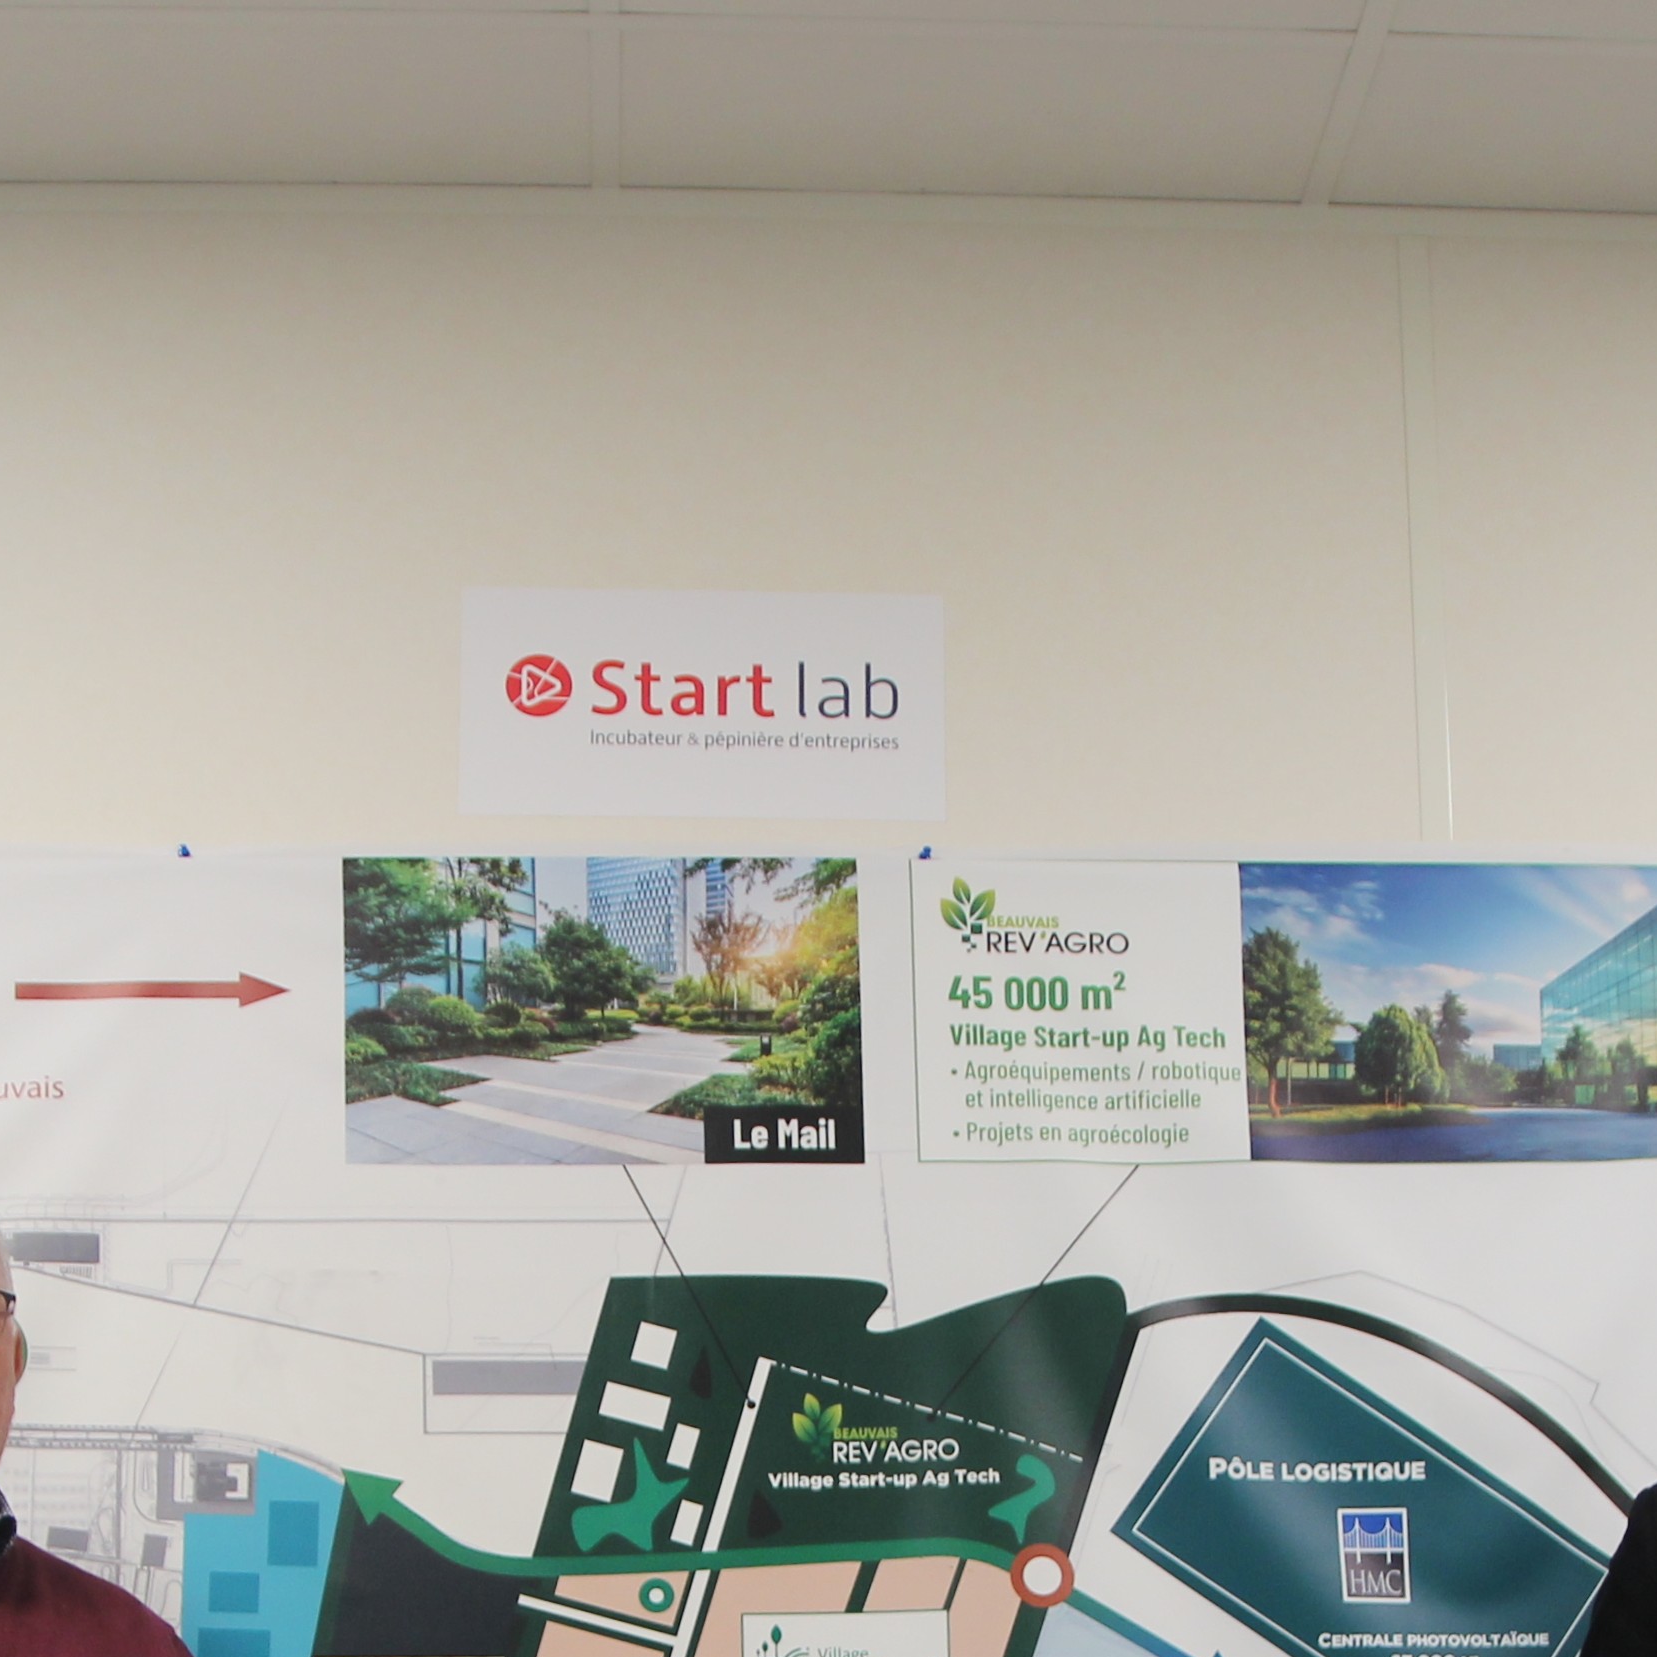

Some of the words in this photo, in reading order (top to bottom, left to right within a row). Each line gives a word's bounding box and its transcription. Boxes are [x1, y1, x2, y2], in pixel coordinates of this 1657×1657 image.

[591, 659, 776, 718] Start
[797, 661, 900, 720] lab
[590, 729, 683, 747] Incubateur
[687, 732, 700, 748] &
[704, 730, 784, 751] pépinière
[789, 732, 900, 752] d'entreprises
[986, 916, 1060, 929] BEAUVAIS
[948, 975, 993, 1011] 45
[1004, 976, 1069, 1011] 000
[949, 1024, 1027, 1051] Village
[1034, 1025, 1130, 1052] Start-up
[1137, 1025, 1166, 1051] Ag
[1173, 1026, 1226, 1048] Tech
[964, 1060, 1131, 1085] Agroéquipements
[1151, 1061, 1242, 1084] robotique
[965, 1091, 984, 1108] et
[990, 1088, 1099, 1113] intelligence
[1104, 1089, 1202, 1110] artificielle
[733, 1119, 769, 1150] Le
[777, 1118, 836, 1150] Mail
[966, 1122, 1034, 1147] Projets
[1039, 1127, 1062, 1142] en
[1067, 1123, 1190, 1147] agroécologie
[833, 1427, 898, 1439] BEAUVAIS
[767, 1472, 834, 1491] Village
[838, 1471, 917, 1490] Start-up
[922, 1469, 949, 1488] Ag
[954, 1467, 1001, 1485] Tech
[1281, 1460, 1427, 1482] LOGISTIQUE
[1349, 1568, 1402, 1598] HMC
[1318, 1632, 1404, 1648] CENTRALE
